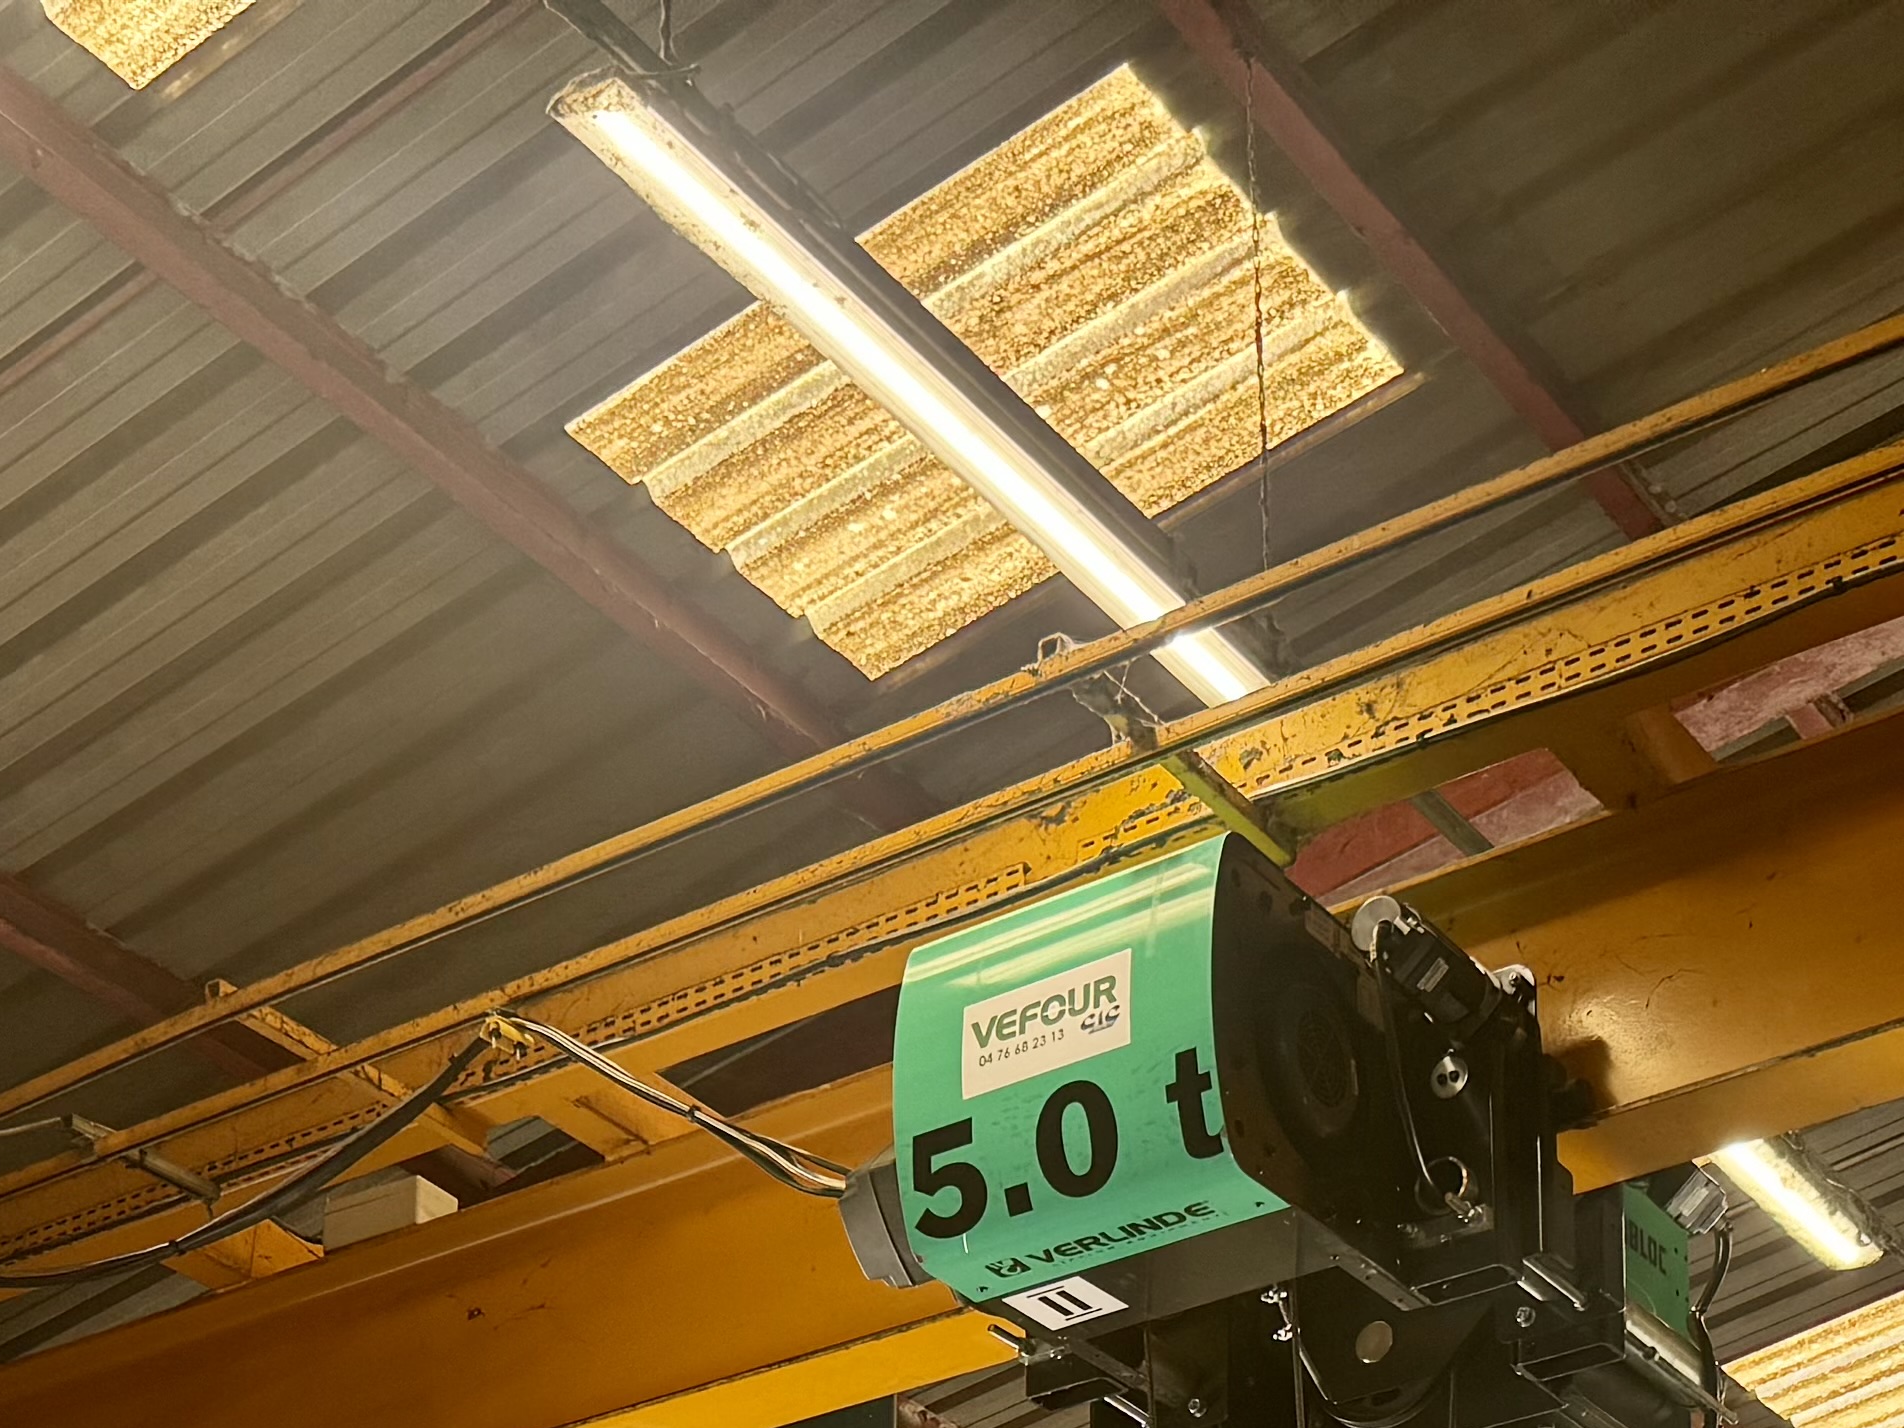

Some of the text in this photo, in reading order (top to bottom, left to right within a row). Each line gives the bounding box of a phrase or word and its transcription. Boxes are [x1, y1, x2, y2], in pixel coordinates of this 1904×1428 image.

[971, 975, 1117, 1048] VEFOUR
[979, 1029, 1065, 1067] 04 76 68 23 13
[912, 1080, 1118, 1239] 5.0
[1165, 1047, 1225, 1159] t
[1025, 1201, 1216, 1264] VERLINDE
